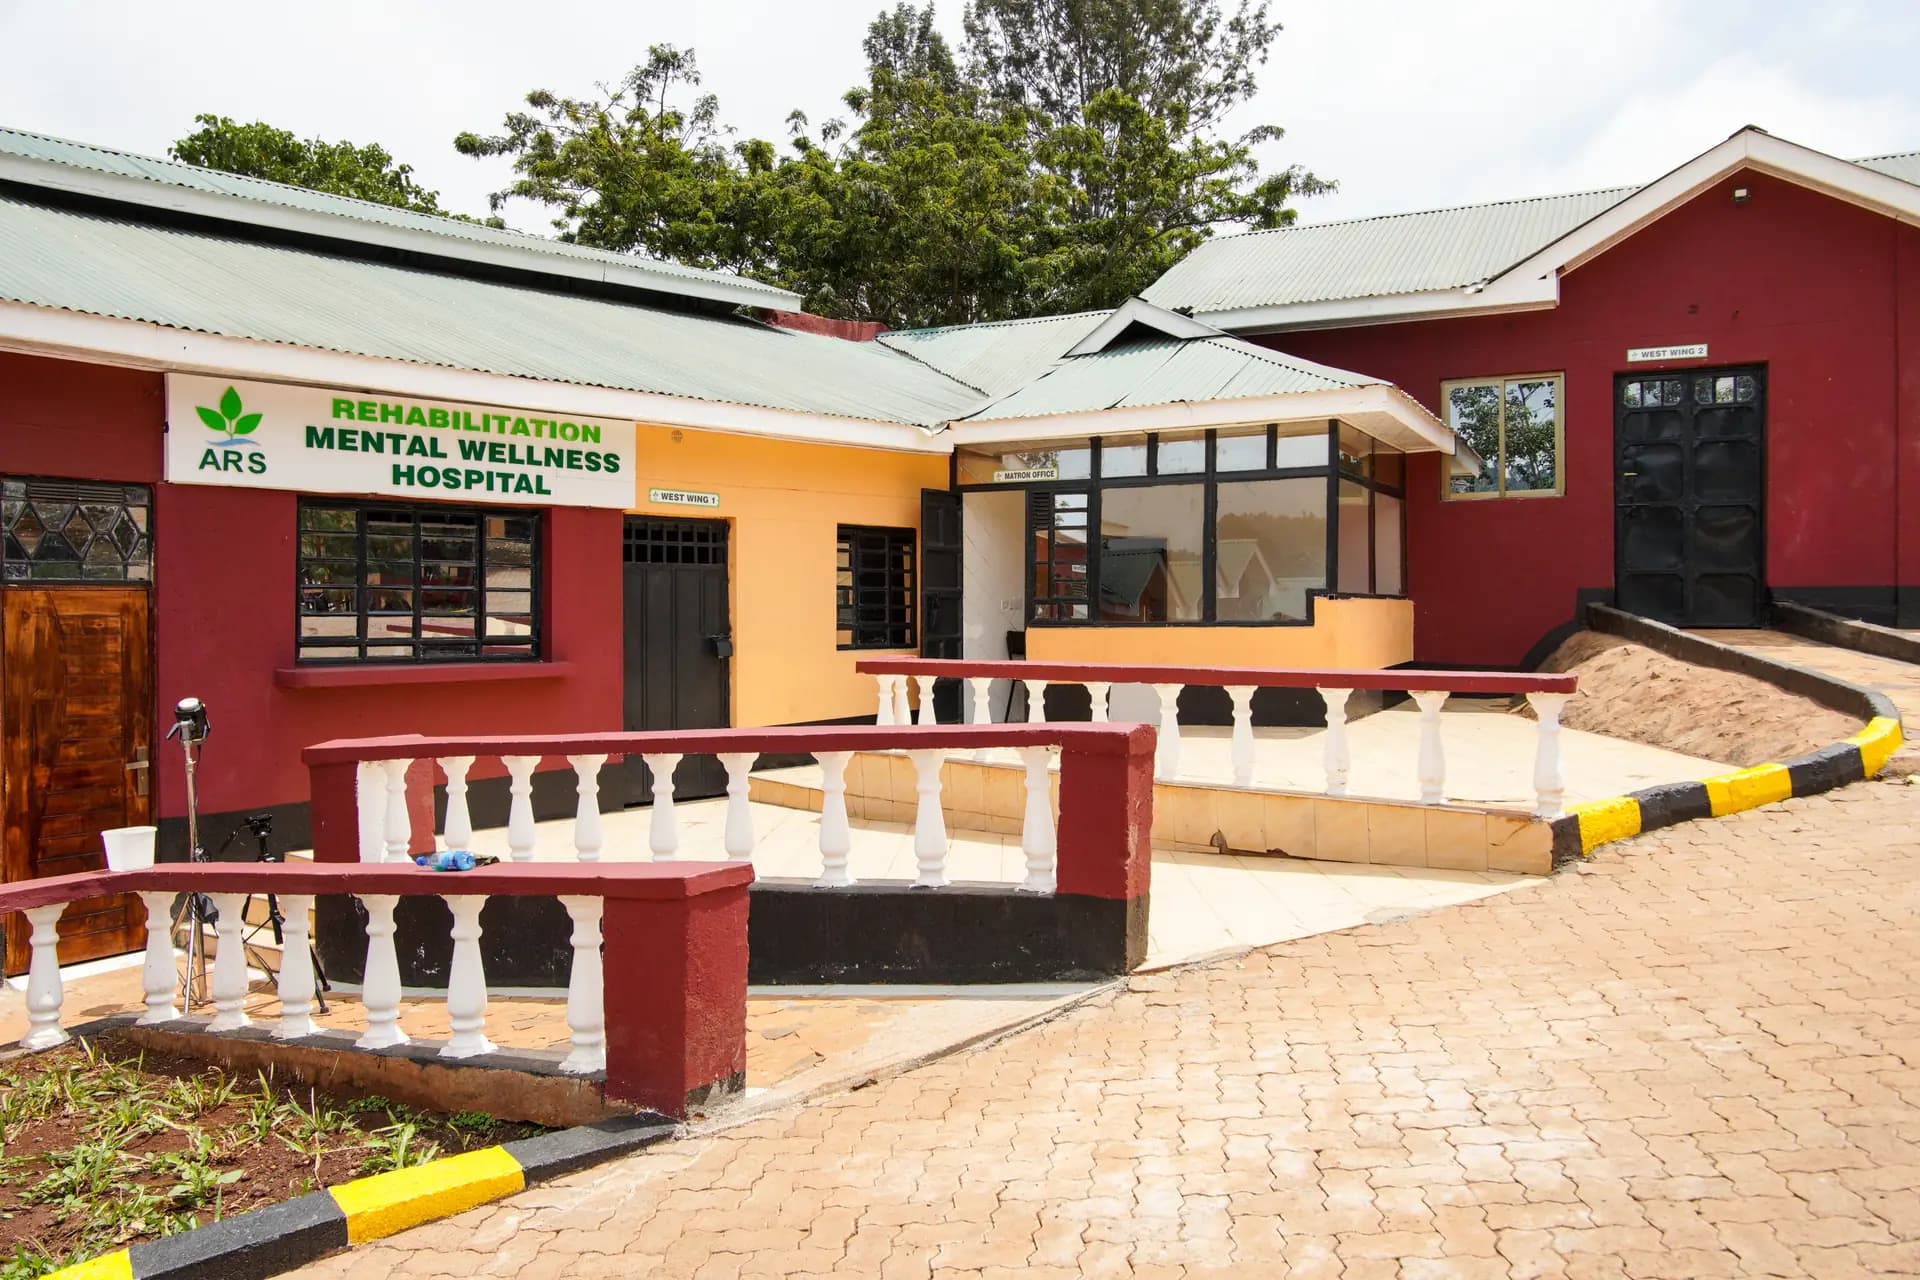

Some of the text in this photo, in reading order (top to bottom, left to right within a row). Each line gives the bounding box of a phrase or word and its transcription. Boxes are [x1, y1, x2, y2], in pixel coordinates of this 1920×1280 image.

[1641, 350, 1667, 358] WEST
[1670, 348, 1695, 356] WING
[332, 398, 601, 444] REHABILITATION
[198, 448, 267, 475] ARS
[305, 426, 621, 473] MENTAL WELLNESS
[392, 464, 552, 495] HOSPITAL
[661, 492, 684, 502] WEST
[687, 494, 709, 503] WING
